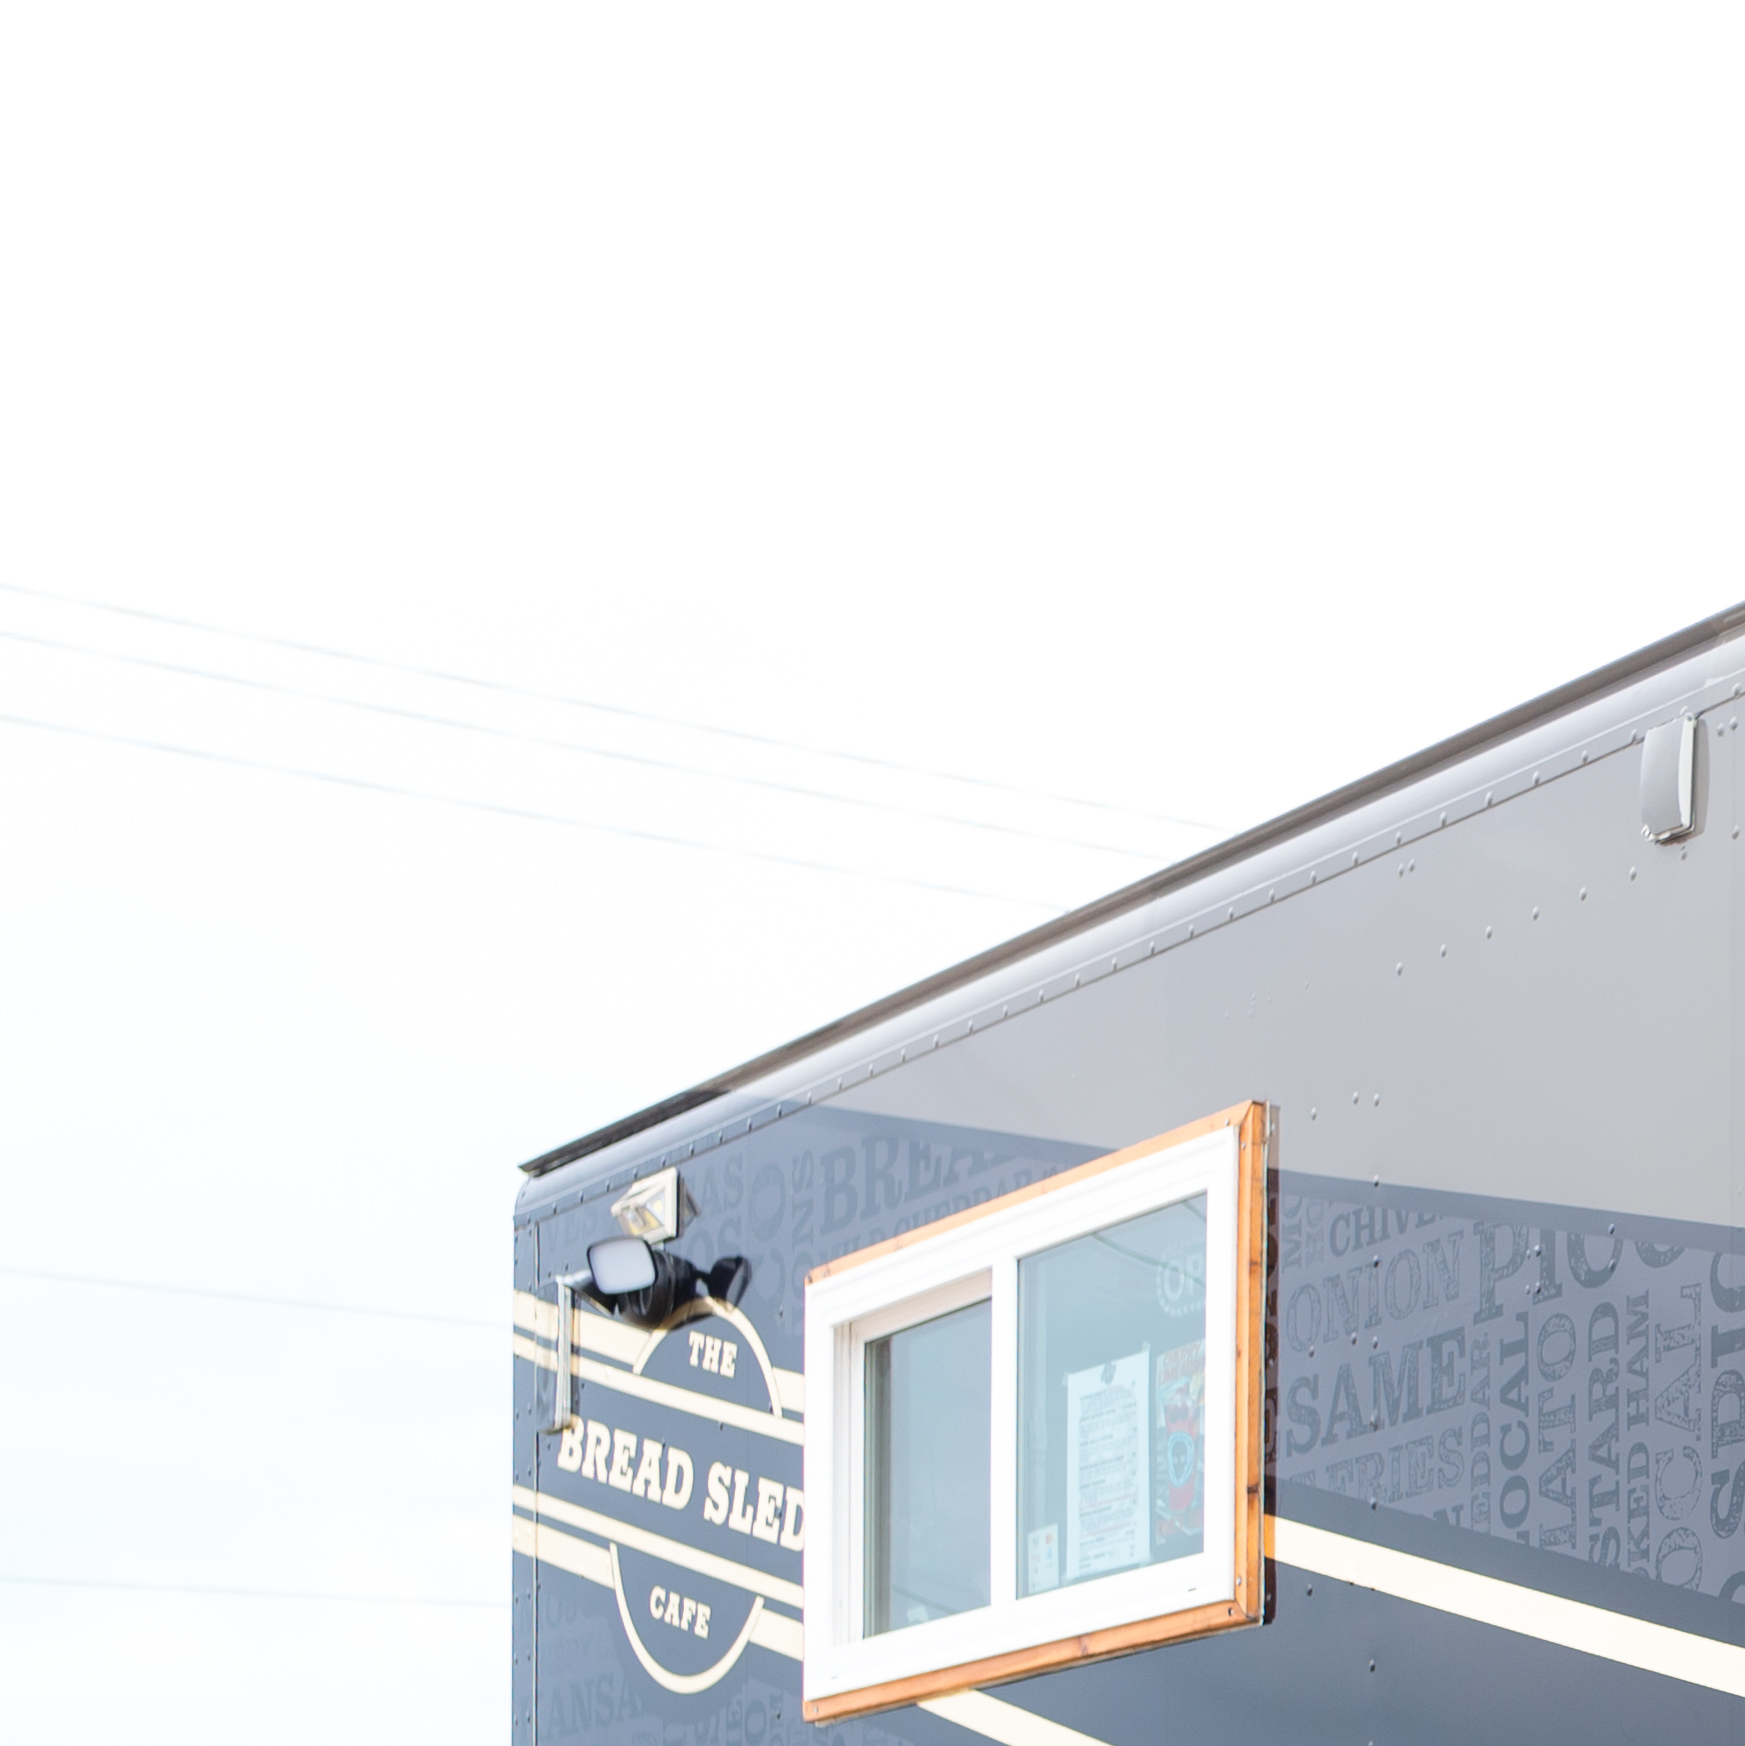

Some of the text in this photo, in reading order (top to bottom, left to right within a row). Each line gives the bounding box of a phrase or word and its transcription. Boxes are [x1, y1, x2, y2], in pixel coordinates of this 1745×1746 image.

[1287, 1228, 1465, 1353] ONION
[688, 1330, 738, 1380] THE
[1627, 1289, 1651, 1432] HAM
[557, 1415, 694, 1512] BREAD
[648, 1585, 712, 1640] CAFE
